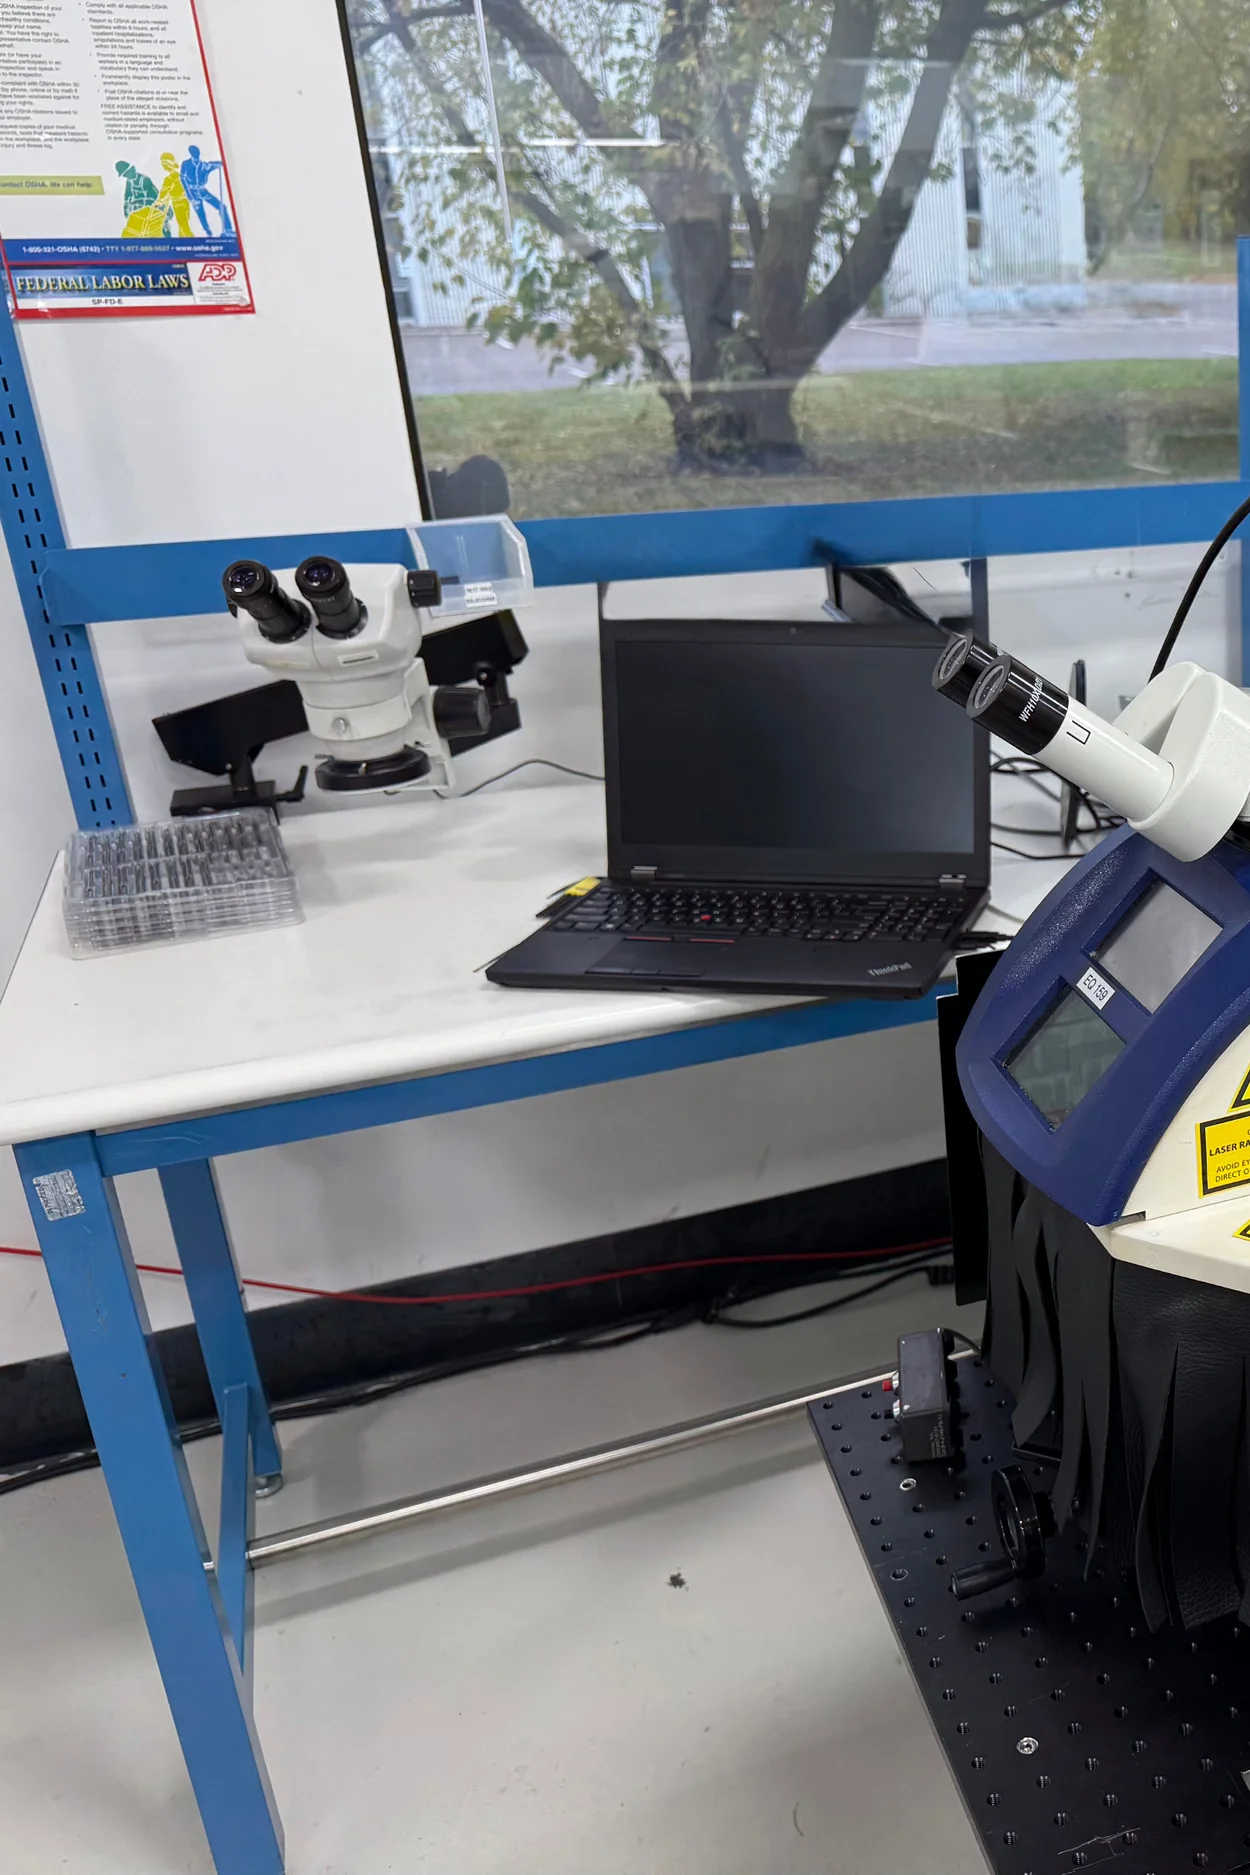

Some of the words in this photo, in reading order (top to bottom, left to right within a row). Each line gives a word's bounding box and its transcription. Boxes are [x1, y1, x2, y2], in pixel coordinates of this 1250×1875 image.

[198, 263, 237, 282] ADP
[16, 275, 88, 292] FEDERAL
[92, 273, 145, 291] LABOR
[148, 272, 189, 290] LAWS
[1084, 974, 1096, 990] EQ
[1094, 985, 1108, 1001] 159
[1209, 1144, 1237, 1156] LASER
[1216, 1162, 1239, 1173] AVOID
[1215, 1170, 1241, 1182] DIRECT
